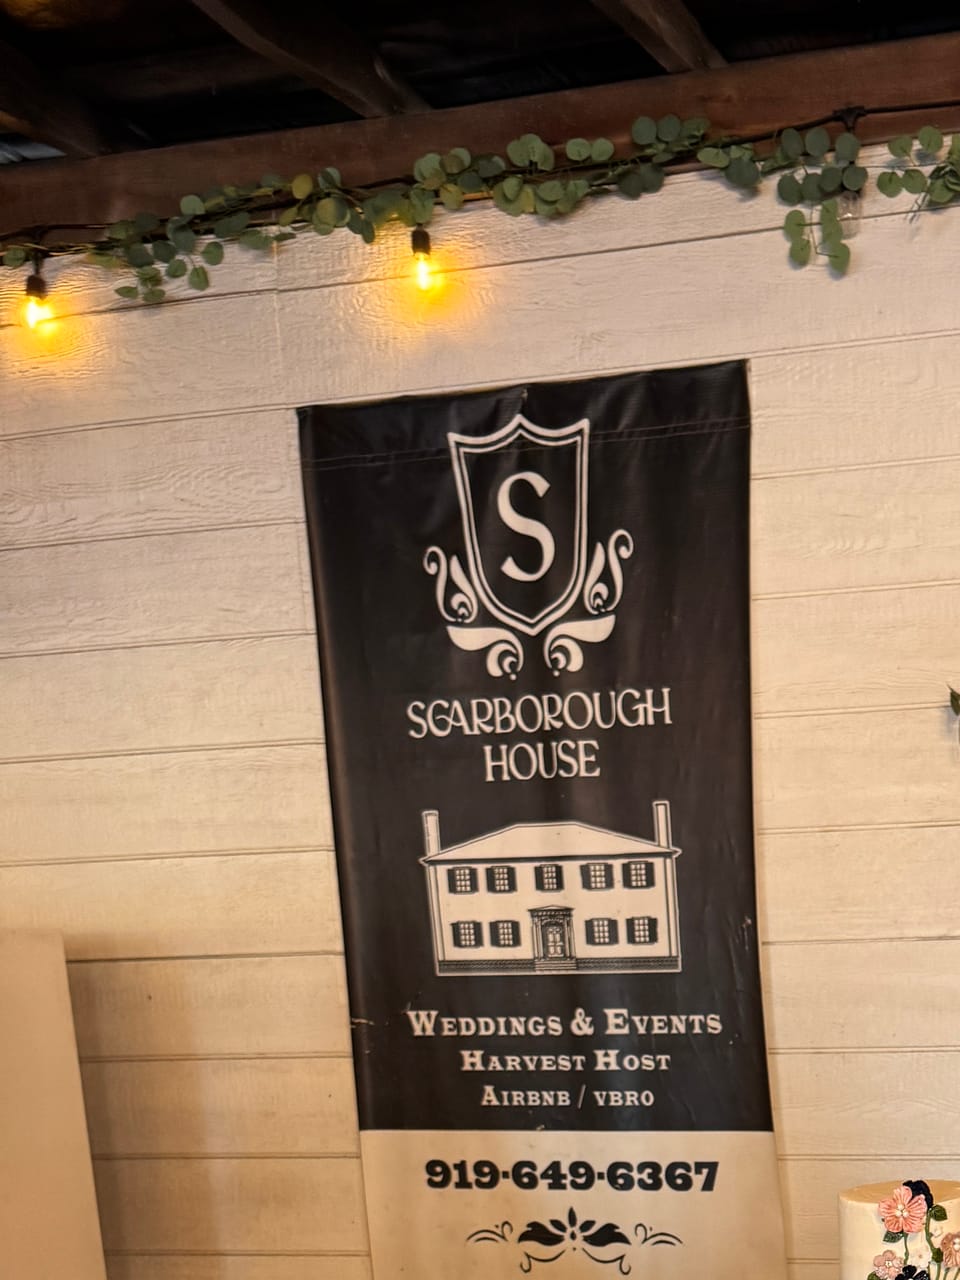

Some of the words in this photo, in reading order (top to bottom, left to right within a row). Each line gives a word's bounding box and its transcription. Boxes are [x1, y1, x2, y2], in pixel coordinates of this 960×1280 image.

[497, 471, 555, 582] S
[406, 688, 673, 739] SCARBOROUGH
[483, 739, 601, 782] HOUSE
[570, 1007, 595, 1036] &
[577, 1084, 586, 1109] /
[425, 1159, 719, 1192] 919-649-6367
